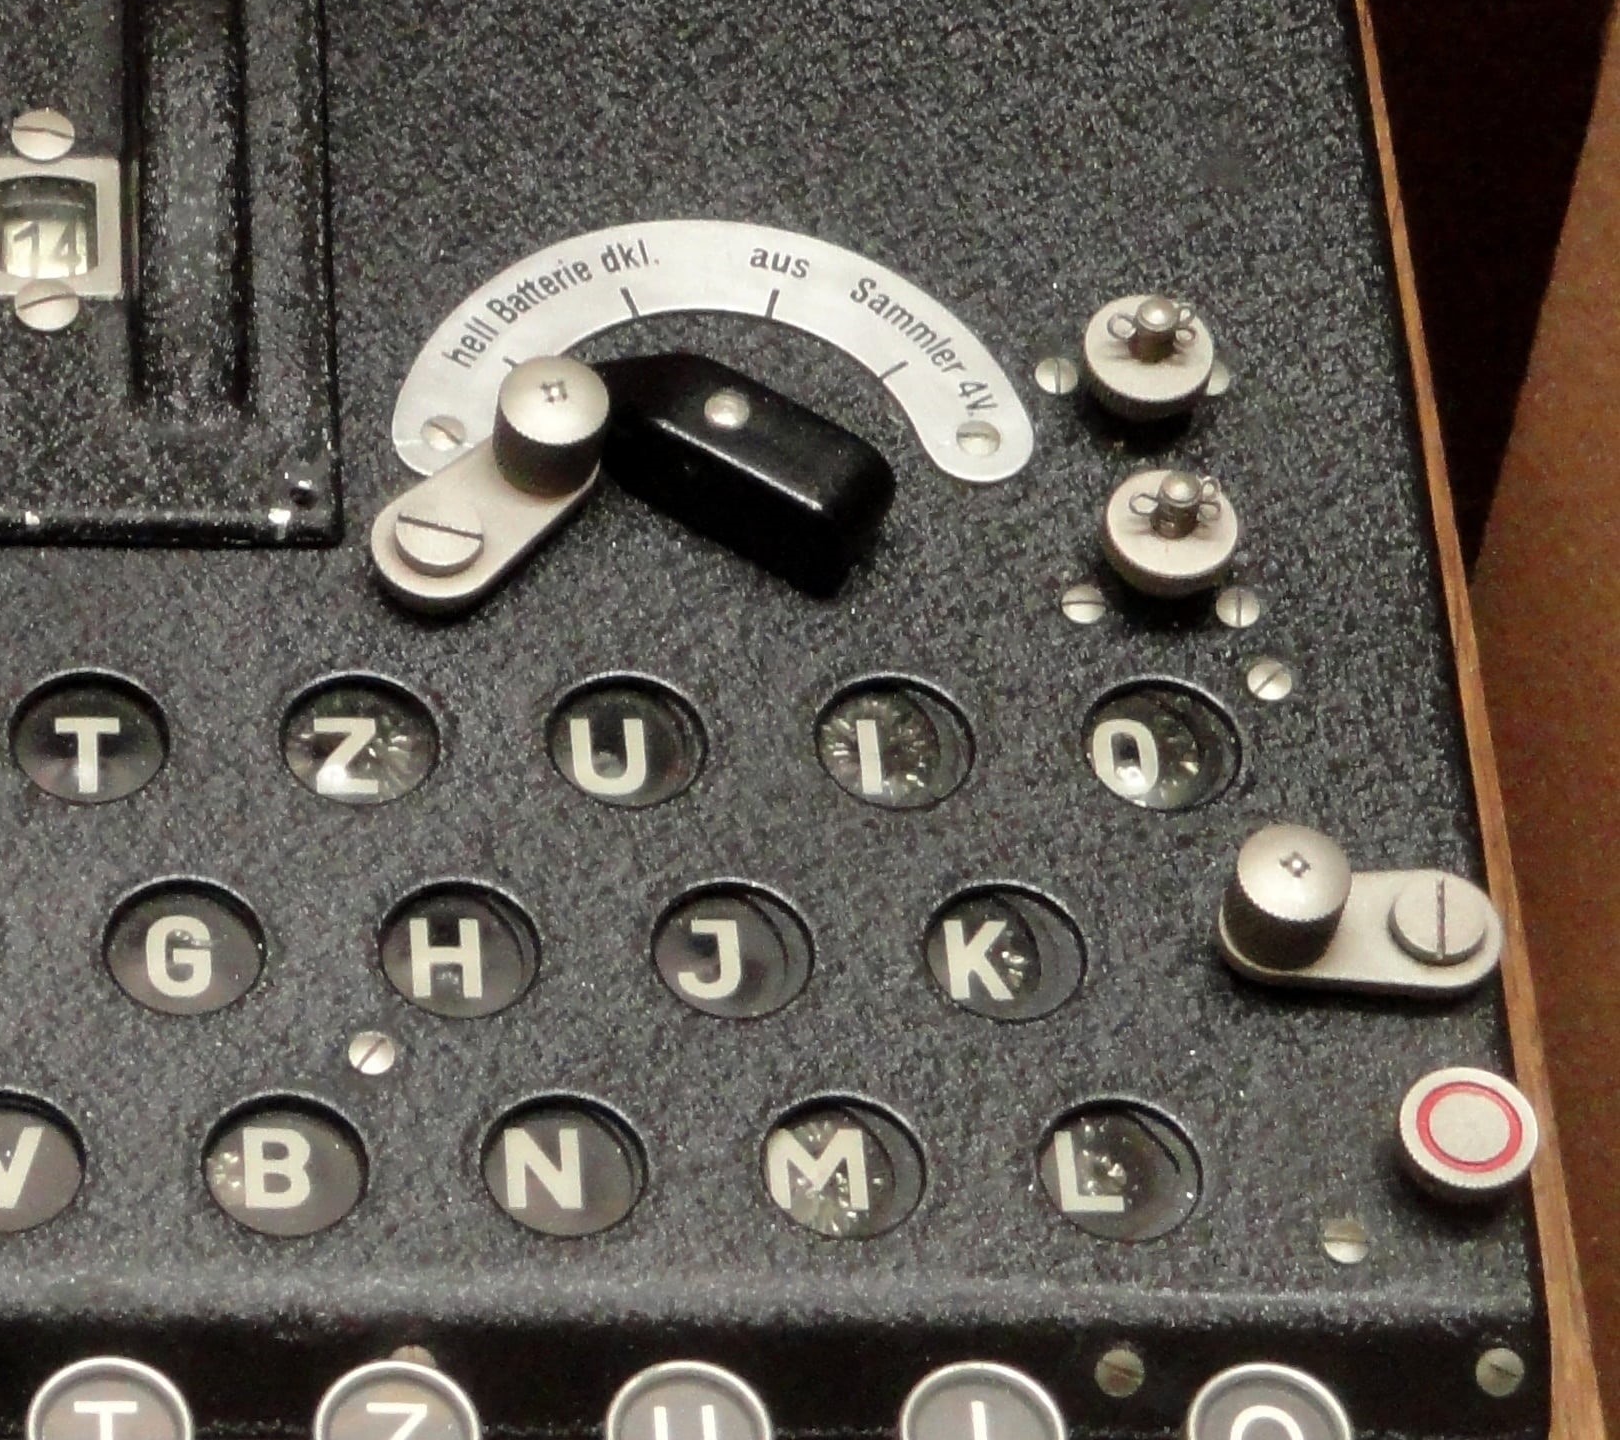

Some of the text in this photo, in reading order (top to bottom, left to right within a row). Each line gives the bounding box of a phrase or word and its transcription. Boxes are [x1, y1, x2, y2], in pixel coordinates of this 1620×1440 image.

[12, 219, 83, 278] 14
[750, 247, 811, 280] aus
[443, 239, 660, 369] hell Batterie dkl.
[848, 276, 967, 377] Sammler
[56, 718, 119, 793] T
[314, 718, 379, 796] Z
[571, 719, 646, 796] U
[857, 720, 893, 795] I
[1093, 719, 1159, 796] O
[146, 916, 211, 998] G
[410, 919, 482, 998] H
[678, 920, 741, 999] J
[945, 921, 1013, 1000] K
[241, 1127, 311, 1209] B
[505, 1129, 582, 1209] N
[769, 1129, 869, 1209] M
[1056, 1132, 1124, 1212] L
